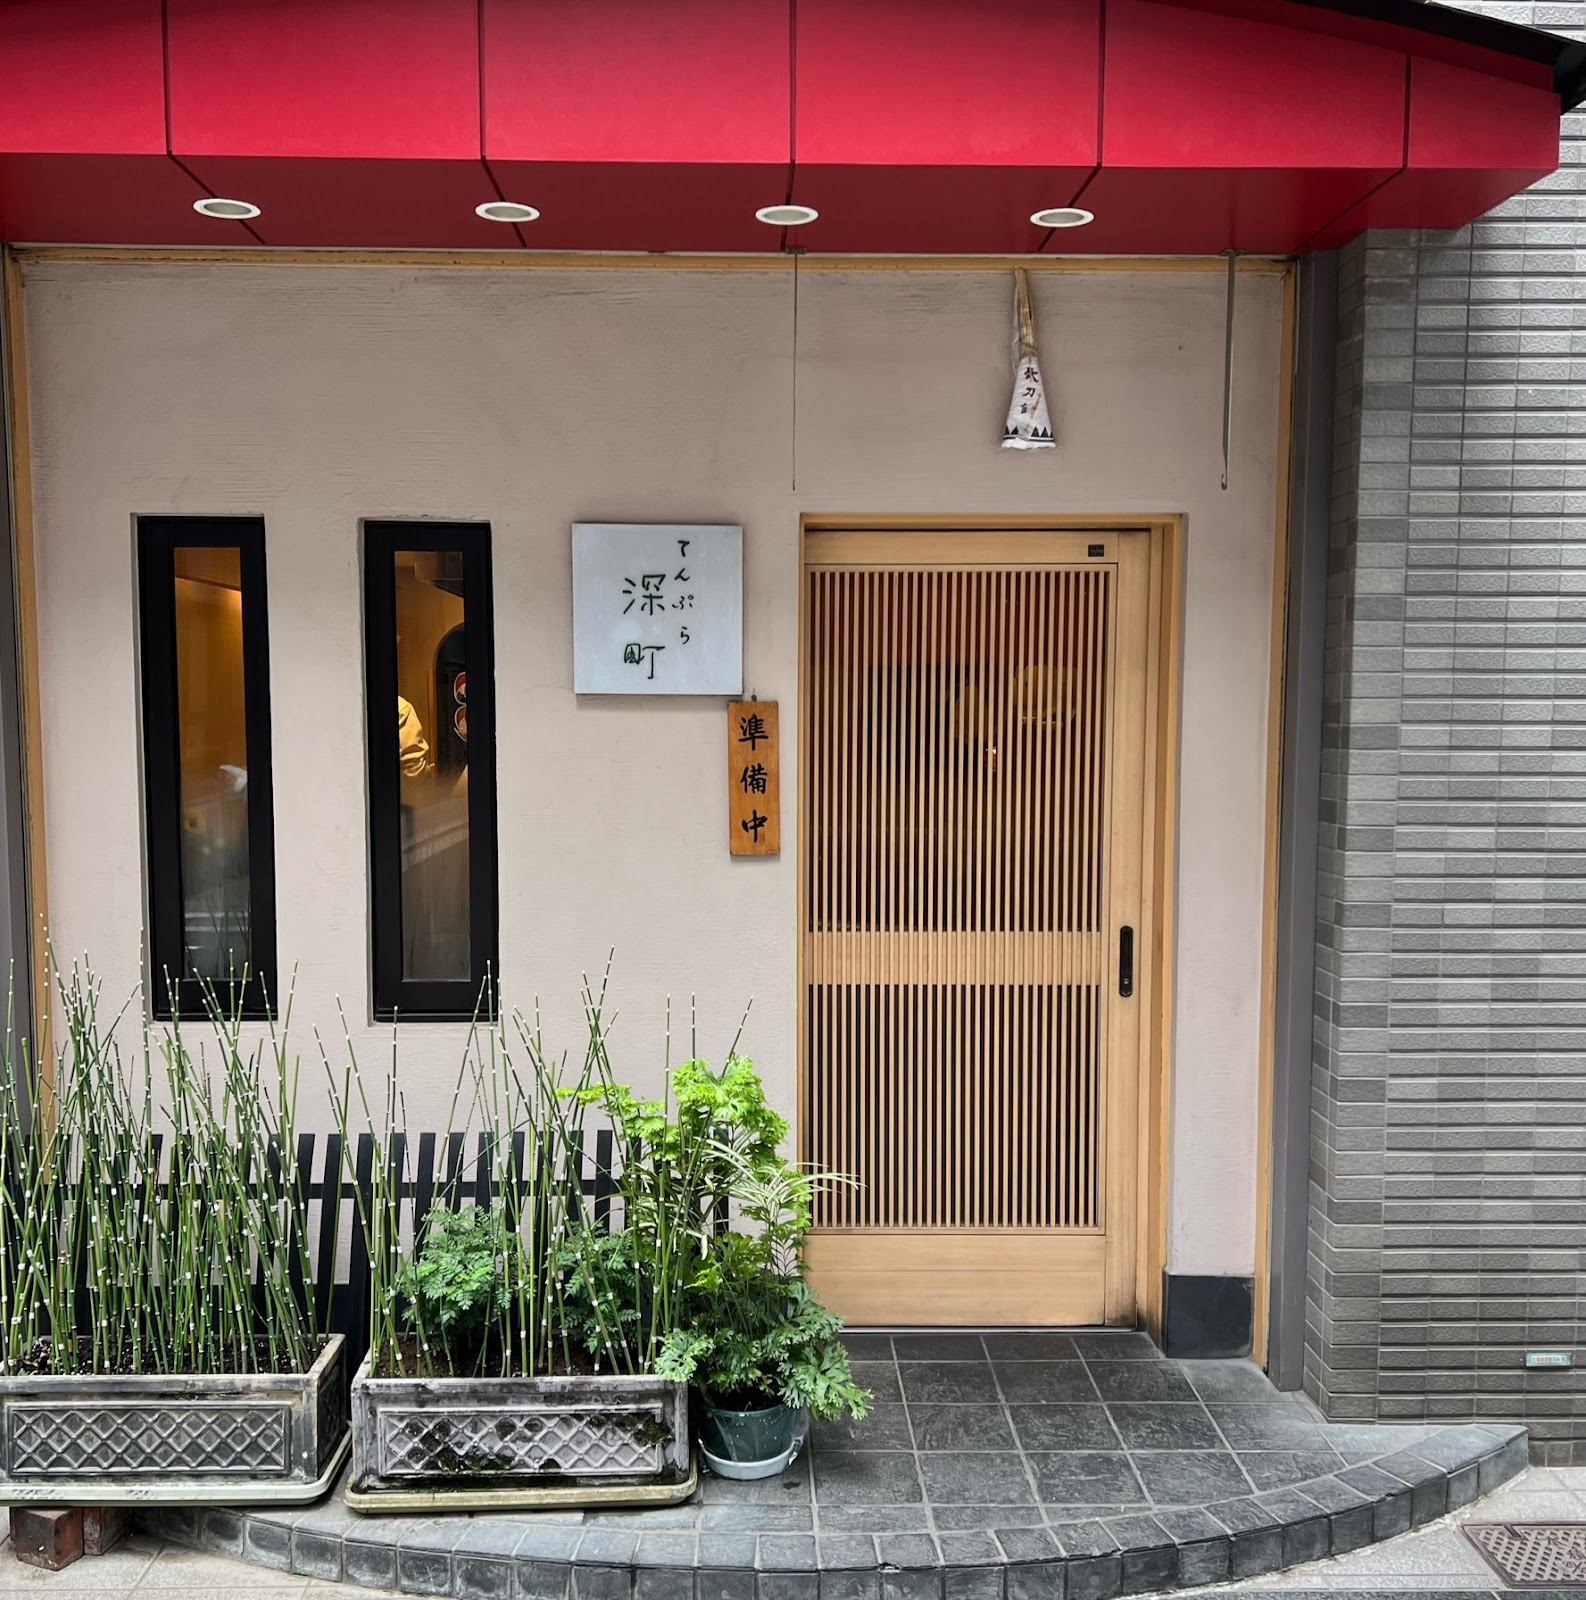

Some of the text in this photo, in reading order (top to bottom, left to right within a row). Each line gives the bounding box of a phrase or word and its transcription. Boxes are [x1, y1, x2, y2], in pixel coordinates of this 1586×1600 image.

[622, 573, 666, 680] 深町
[671, 539, 695, 645] てんぷら
[738, 713, 769, 844] 準備中
